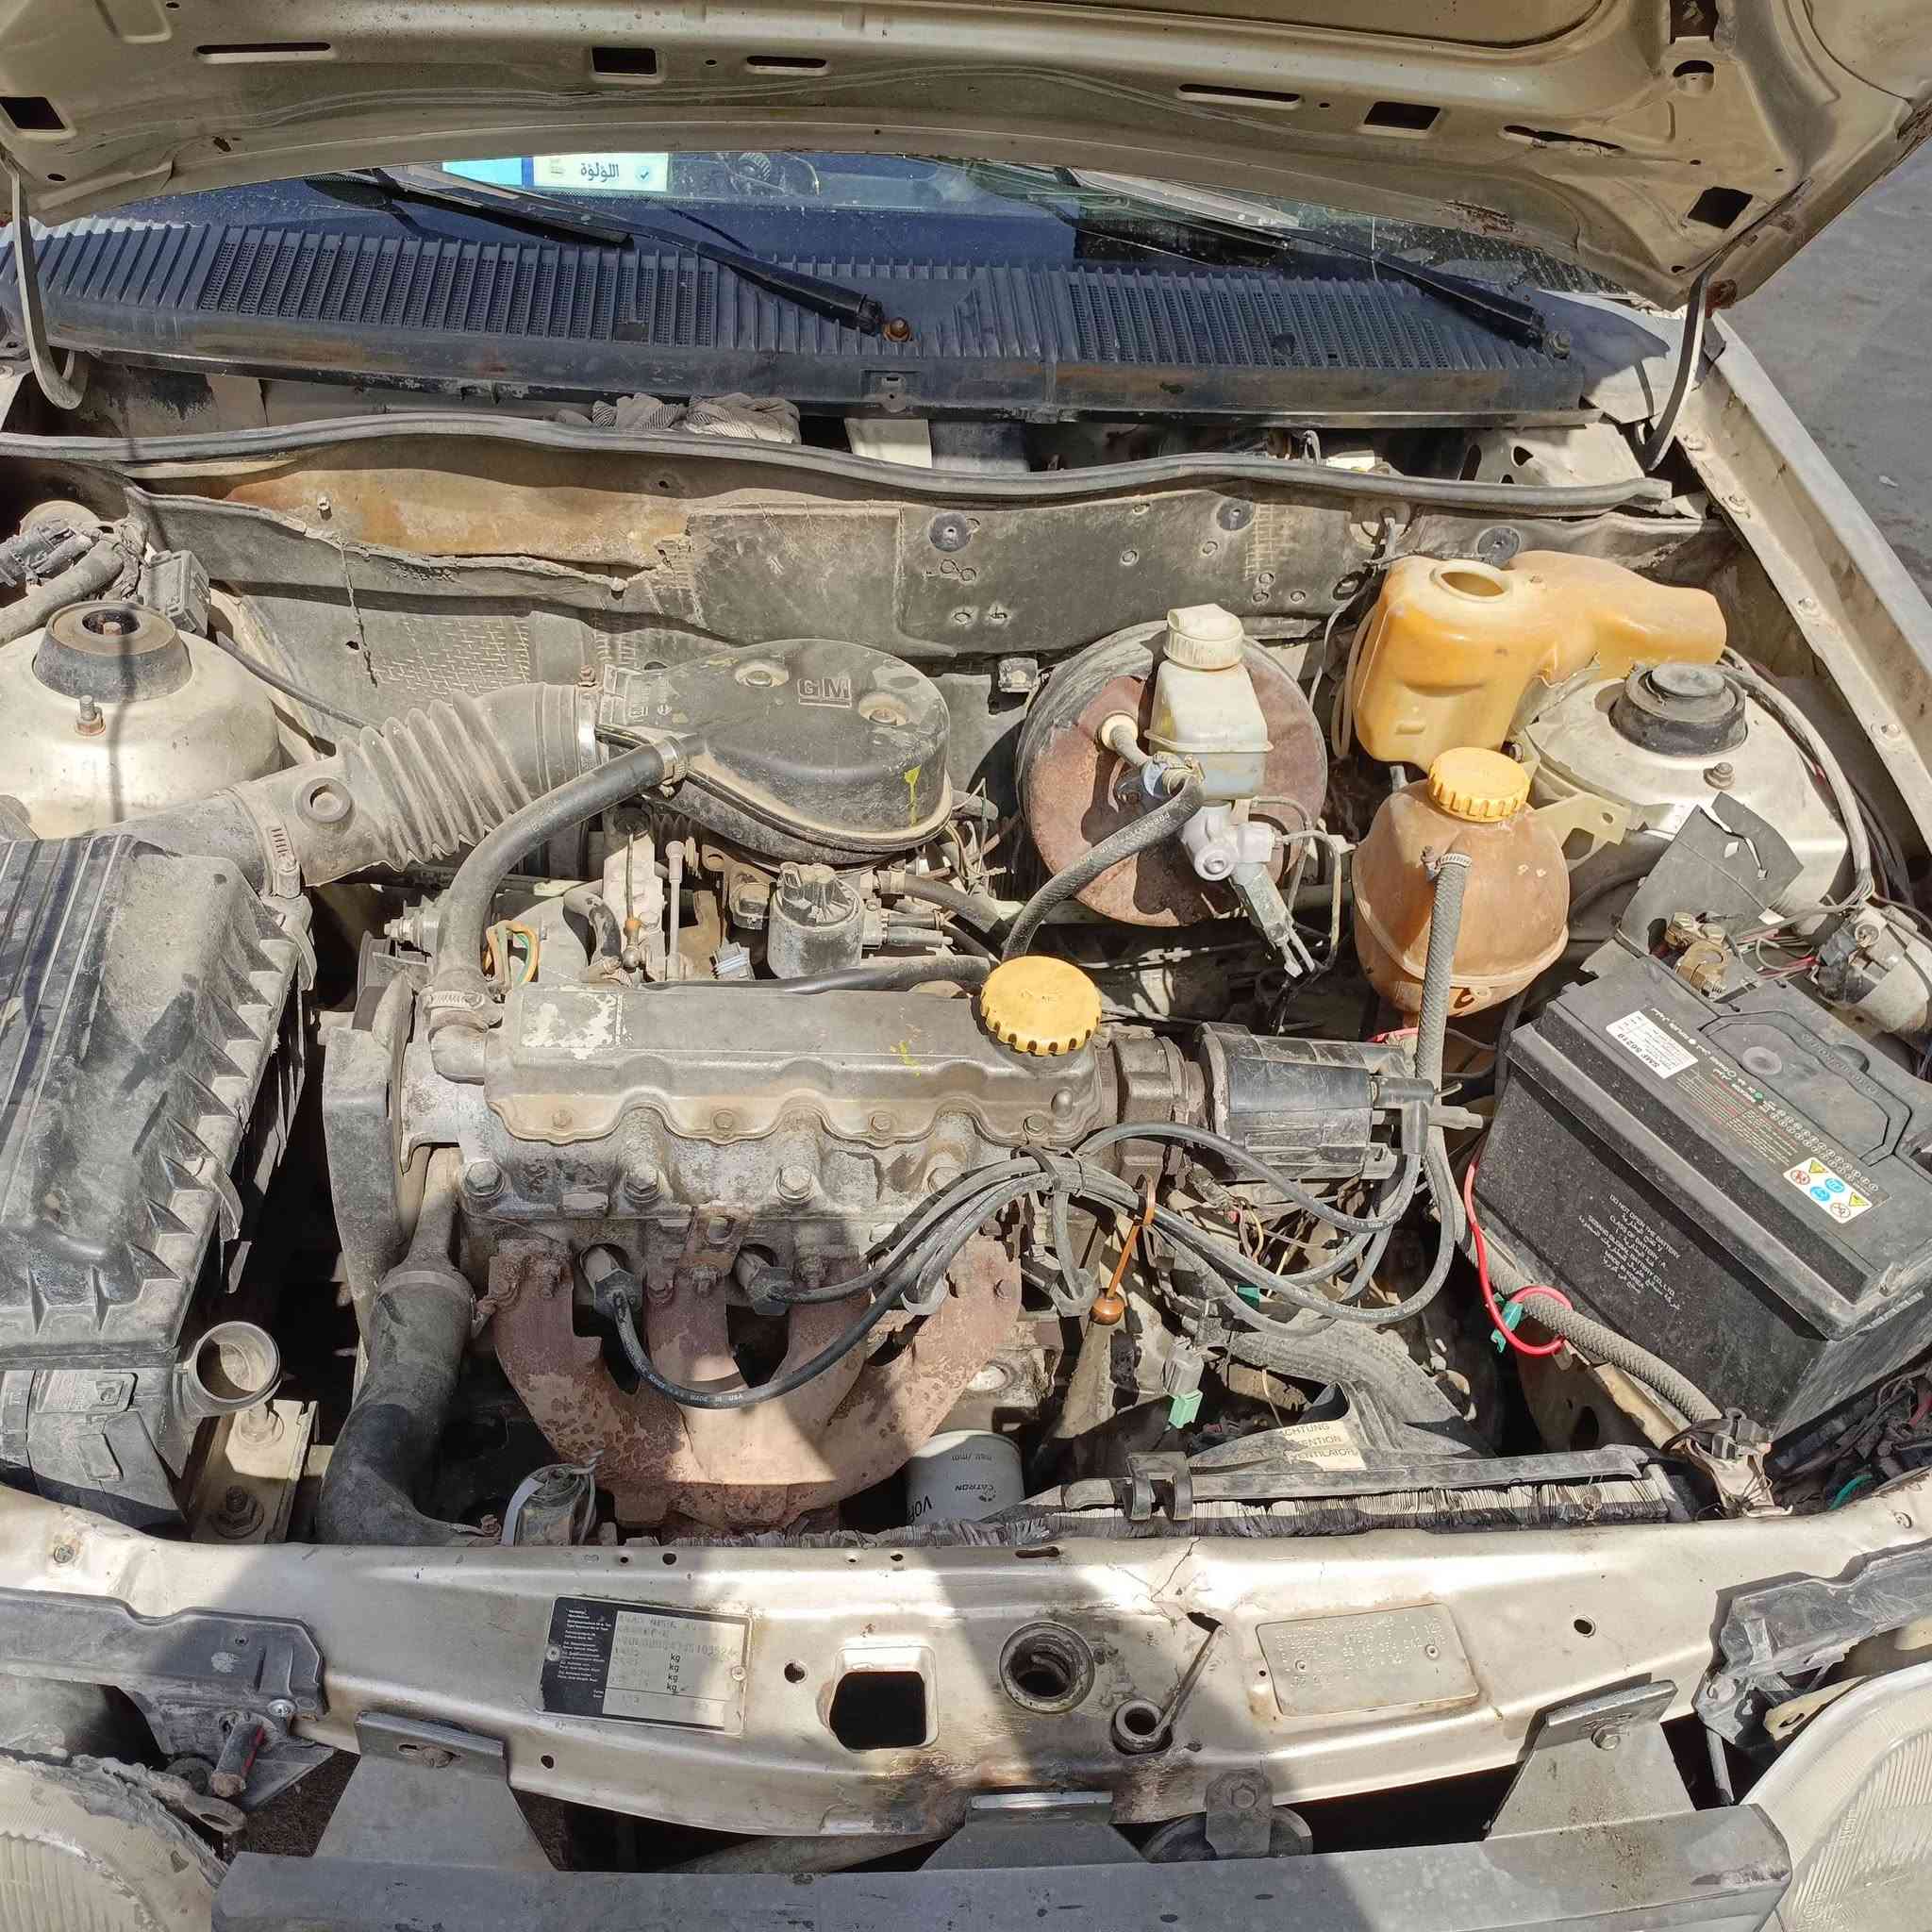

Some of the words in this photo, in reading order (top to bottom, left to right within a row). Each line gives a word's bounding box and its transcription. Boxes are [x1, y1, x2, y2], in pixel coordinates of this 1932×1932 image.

[580, 160, 620, 183] اللؤلؤة
[797, 677, 851, 700] GM
[1655, 1235, 1681, 1259] BATTERY
[1300, 1435, 1342, 1448] ENTION
[670, 1653, 680, 1663] kg
[669, 1662, 679, 1673] kg
[668, 1673, 678, 1683] kg
[666, 1682, 677, 1692] kg
